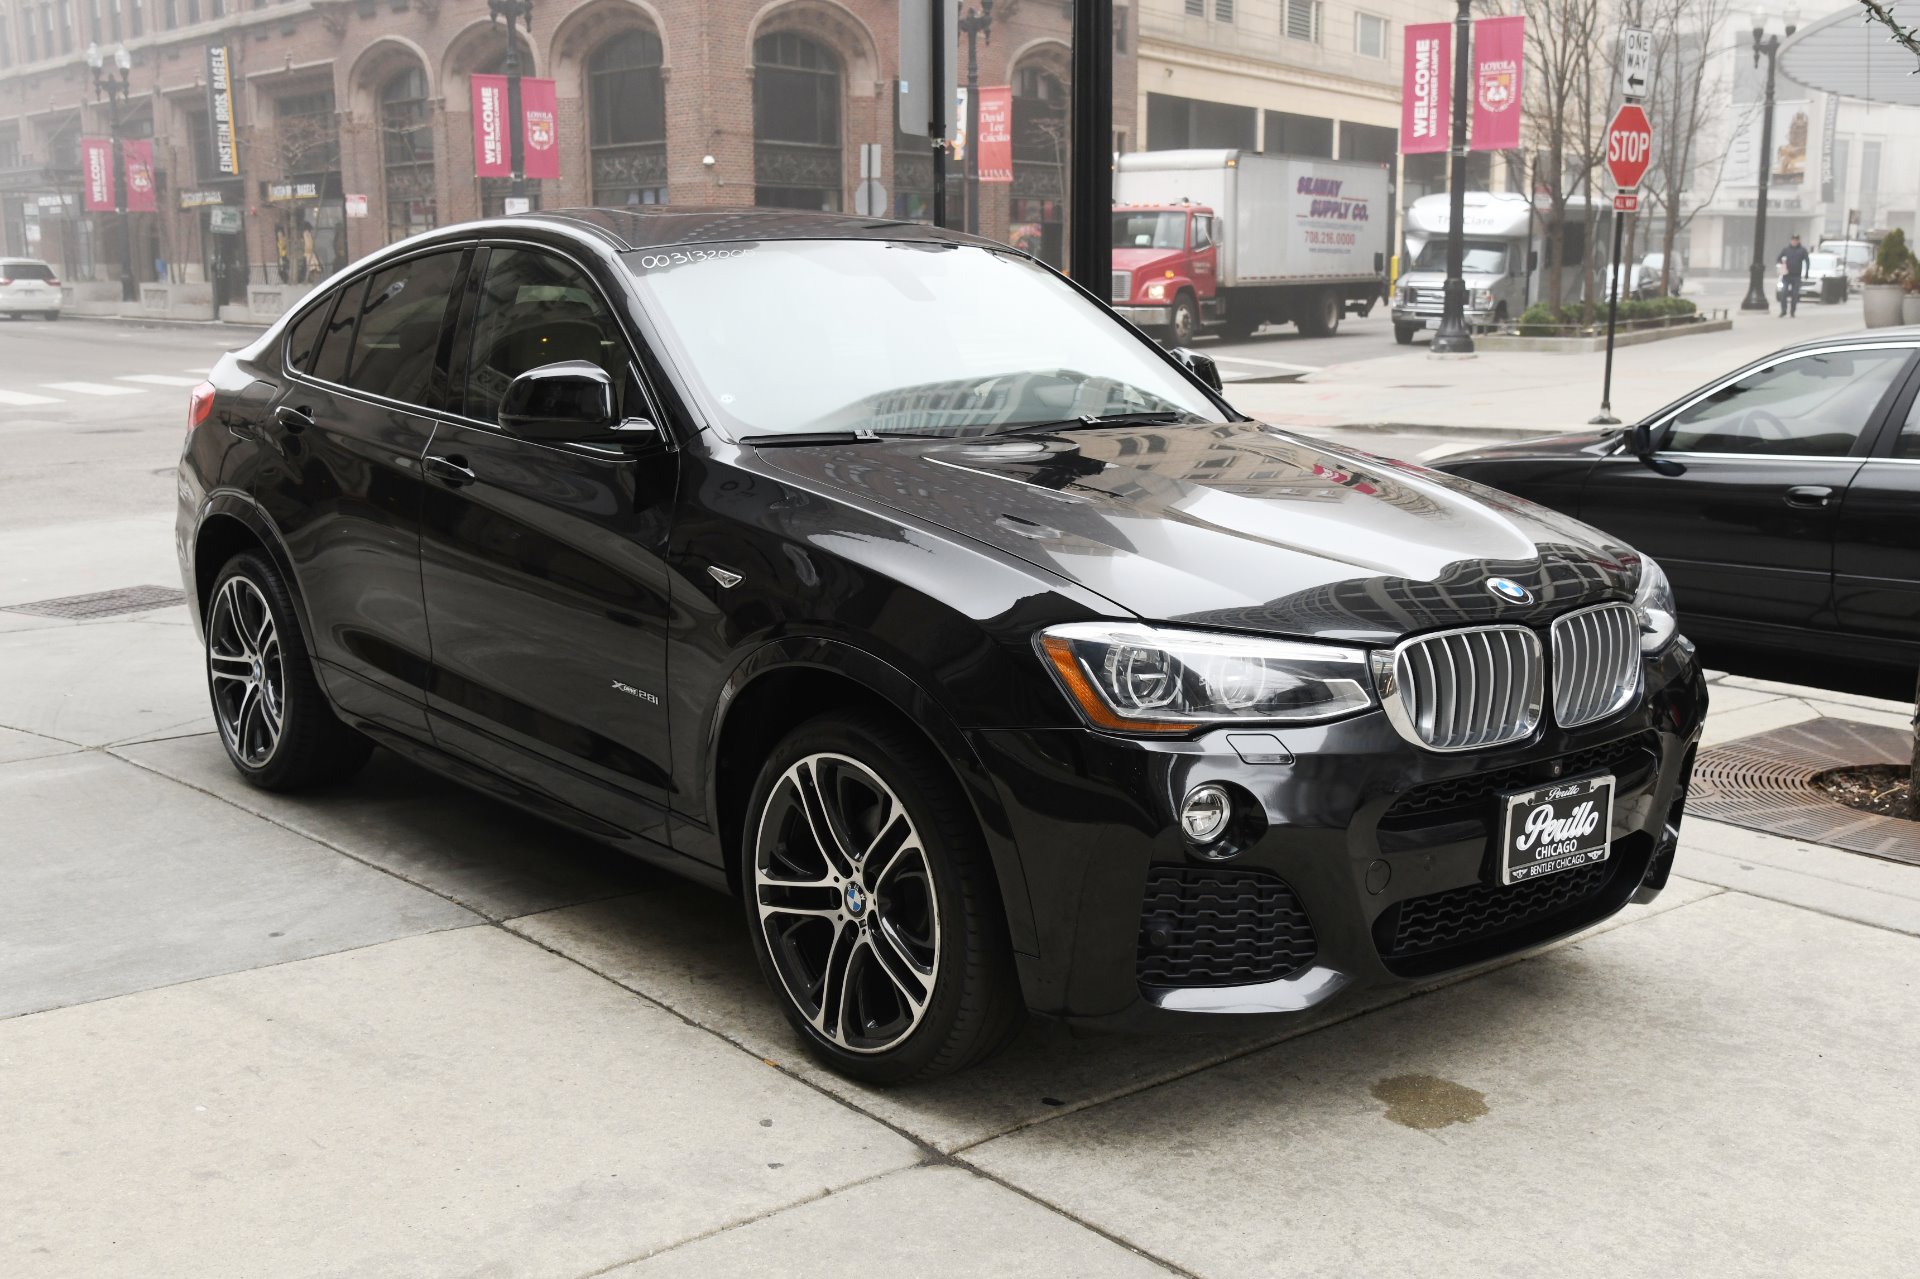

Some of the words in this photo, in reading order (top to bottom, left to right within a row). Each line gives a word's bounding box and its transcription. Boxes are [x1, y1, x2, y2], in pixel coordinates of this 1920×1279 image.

[1628, 34, 1649, 51] ONE
[211, 47, 227, 90] BAGELS
[1480, 60, 1516, 72] LOYOLA
[1626, 55, 1648, 69] WAY
[1413, 39, 1430, 138] WELCOME
[481, 87, 496, 165] WELCOME
[526, 111, 554, 120] LOYOLA
[1429, 108, 1437, 138] WATER
[217, 123, 233, 172] EINSTEIN
[1609, 130, 1650, 163] STOP
[89, 147, 103, 203] WELCOME
[1297, 176, 1343, 197] SEAWAY
[1310, 199, 1351, 219] SUPPLY
[1615, 198, 1624, 208] ALL
[1625, 198, 1636, 208] WAY
[1516, 801, 1599, 851] Perillo
[1535, 839, 1578, 860] CHICAGO
[1530, 861, 1557, 876] BENTLEY
[1556, 853, 1586, 869] CHICAGO
